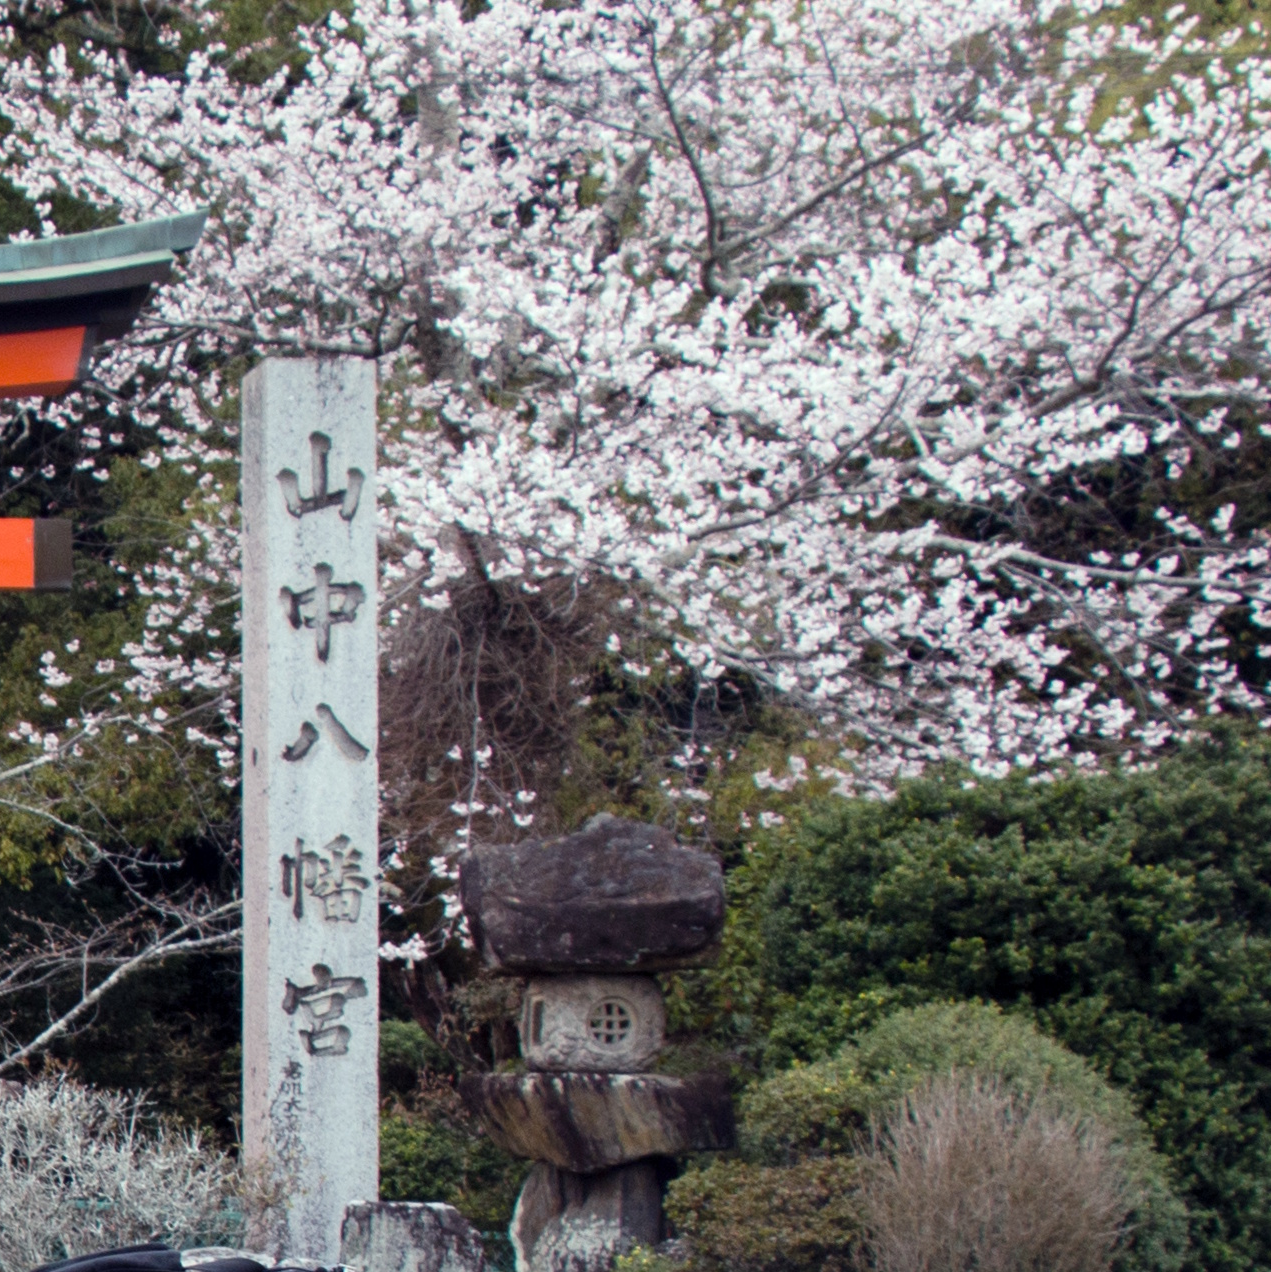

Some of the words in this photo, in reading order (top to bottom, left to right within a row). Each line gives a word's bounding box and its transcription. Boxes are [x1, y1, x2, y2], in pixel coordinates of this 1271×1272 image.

[275, 430, 370, 1057] 山中八幡宮
